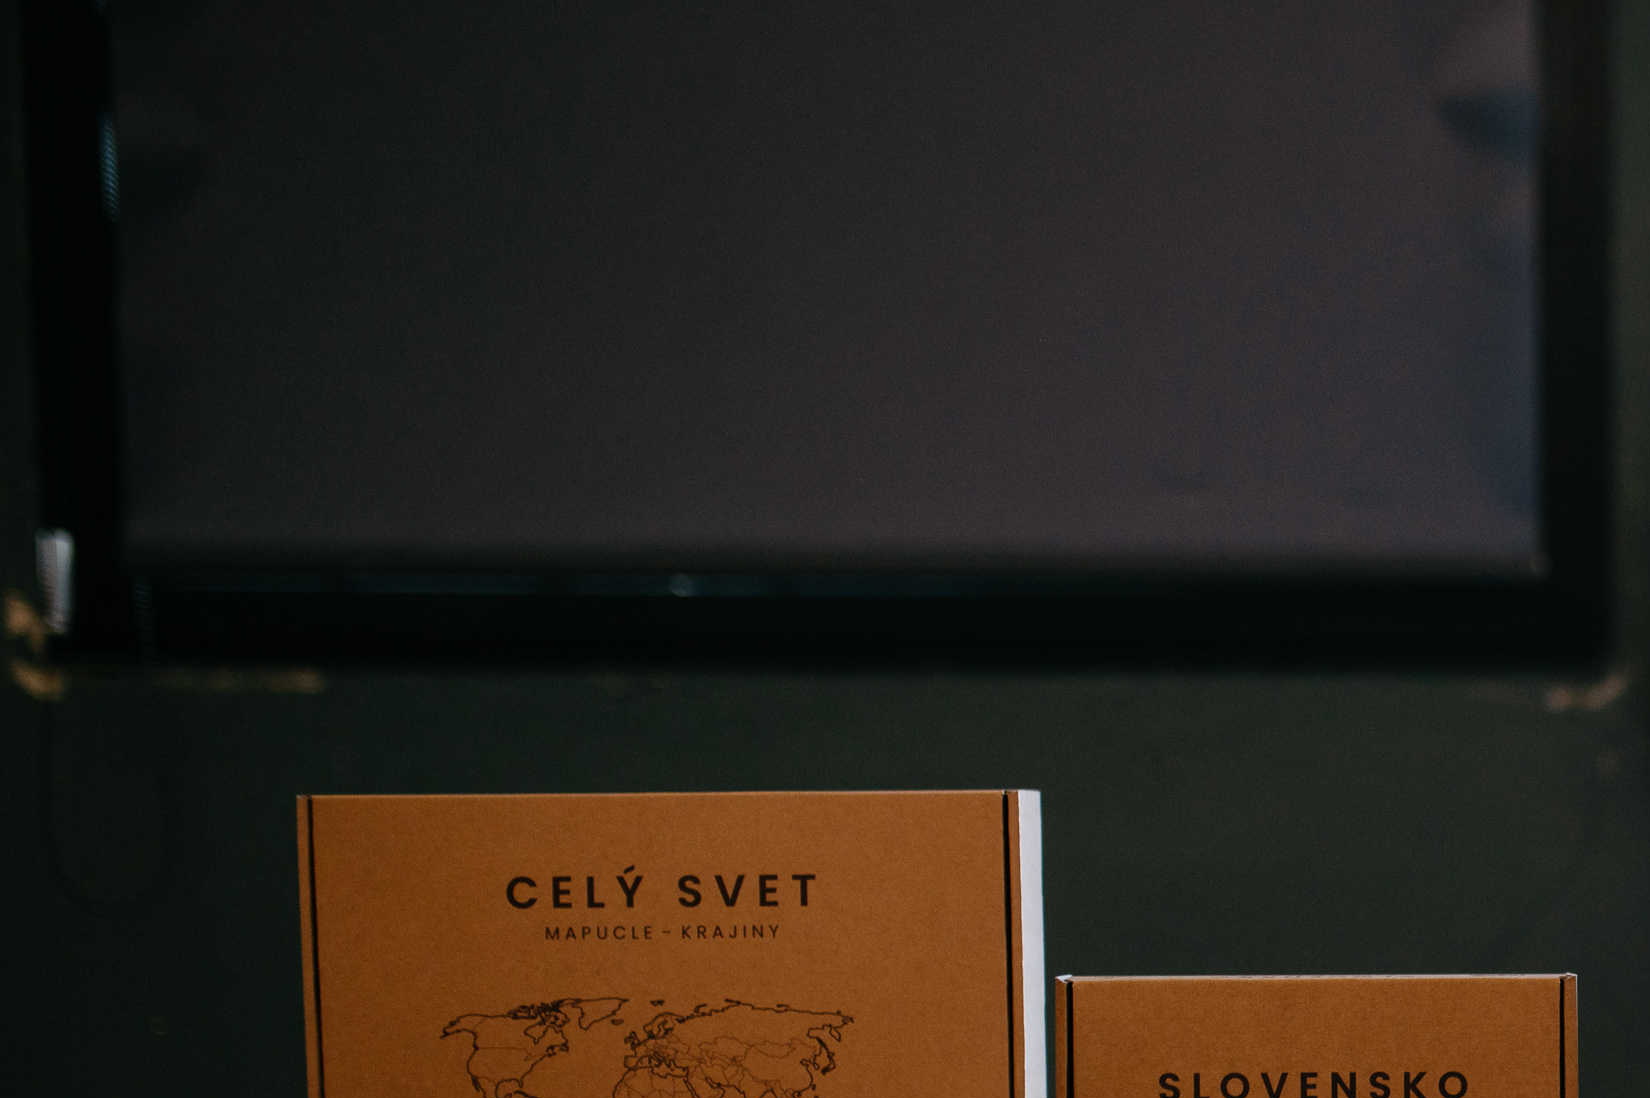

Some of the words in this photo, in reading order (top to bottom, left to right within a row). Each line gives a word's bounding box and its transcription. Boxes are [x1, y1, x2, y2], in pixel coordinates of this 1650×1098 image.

[506, 864, 643, 909] CELÝ
[678, 874, 816, 908] SVET
[545, 926, 653, 940] MAPUCLE
[681, 924, 780, 939] KRAJINY
